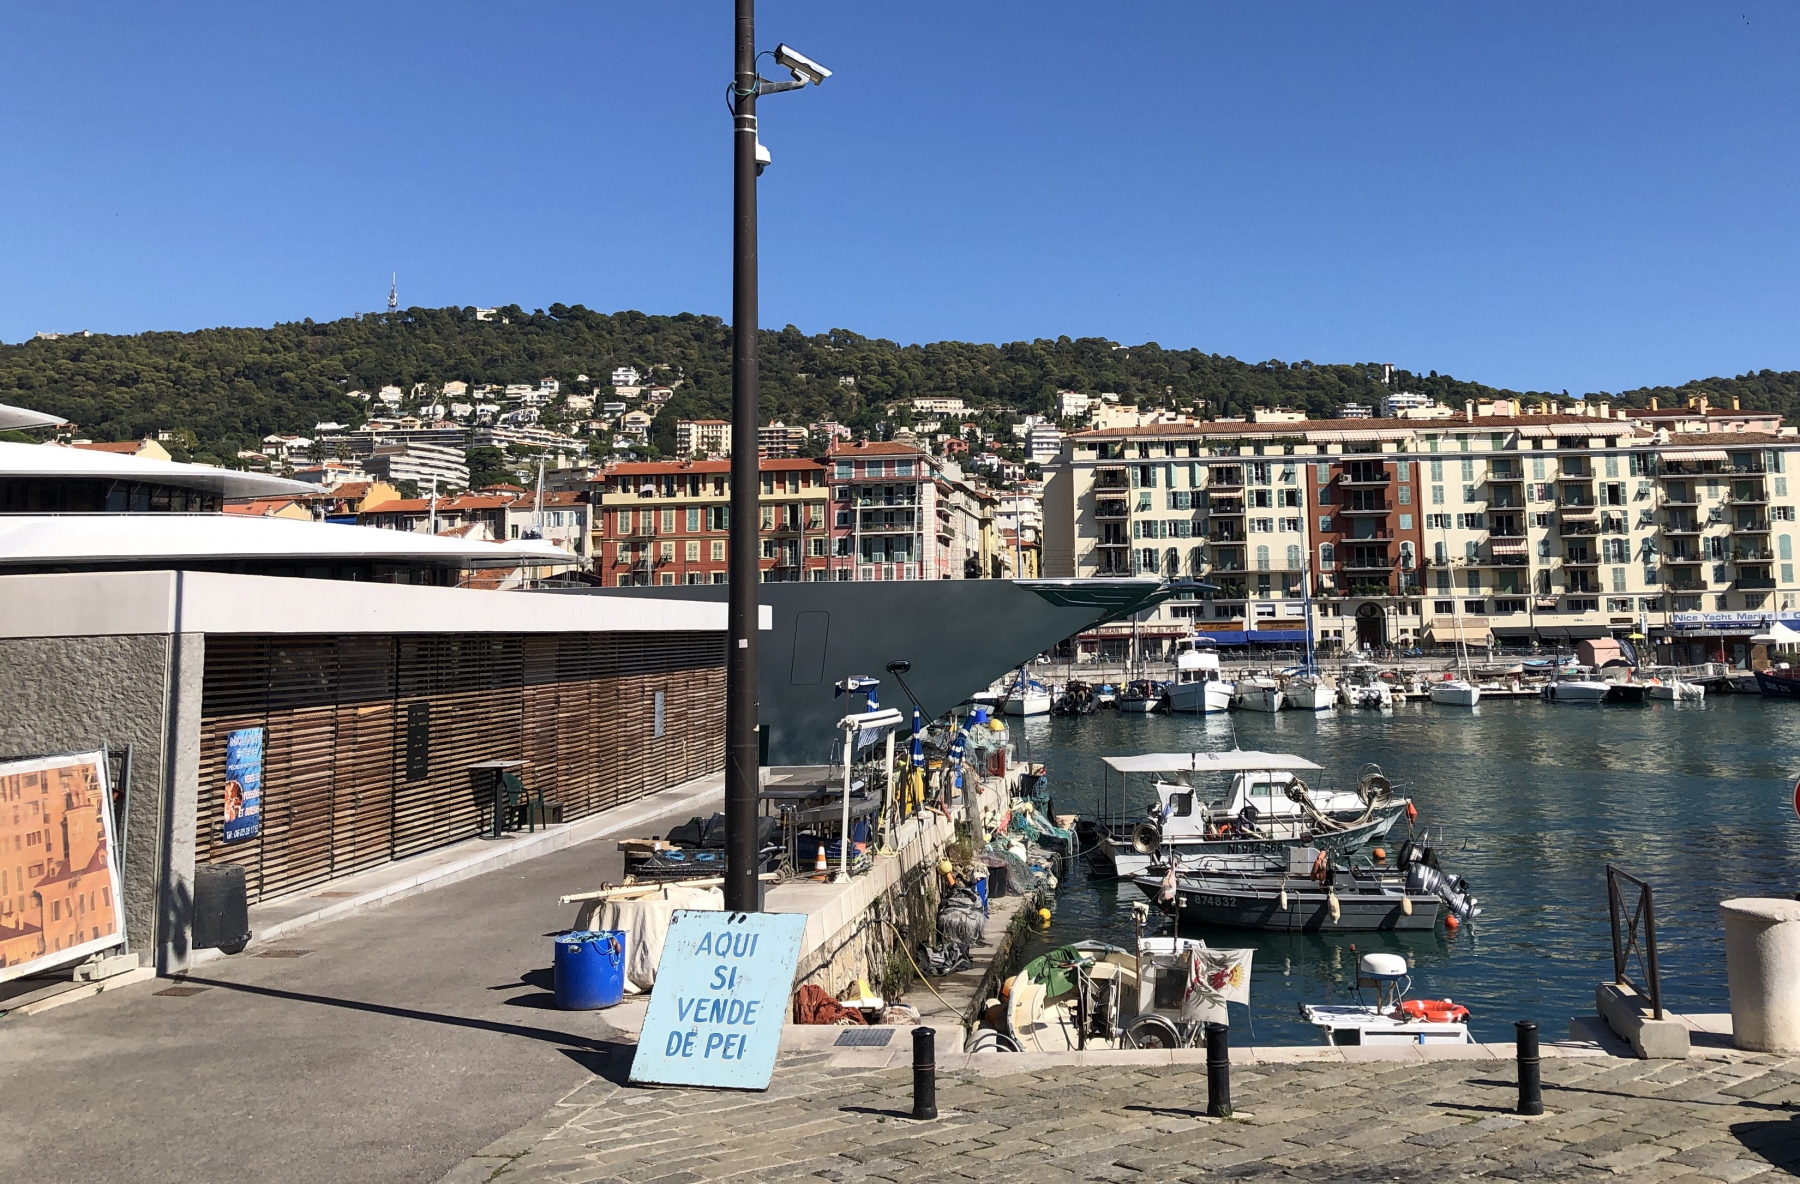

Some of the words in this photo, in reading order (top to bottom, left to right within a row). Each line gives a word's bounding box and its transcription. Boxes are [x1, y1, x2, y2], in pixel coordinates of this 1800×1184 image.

[1703, 613, 1733, 621] Yacht
[1737, 612, 1773, 620] Marine
[1242, 843, 1261, 854] 934
[1264, 842, 1283, 853] 568
[1194, 894, 1237, 907] 874832
[695, 931, 760, 959] AQUI
[709, 965, 738, 991] SI
[678, 997, 761, 1026] VENDE
[704, 1032, 747, 1060] PEI
